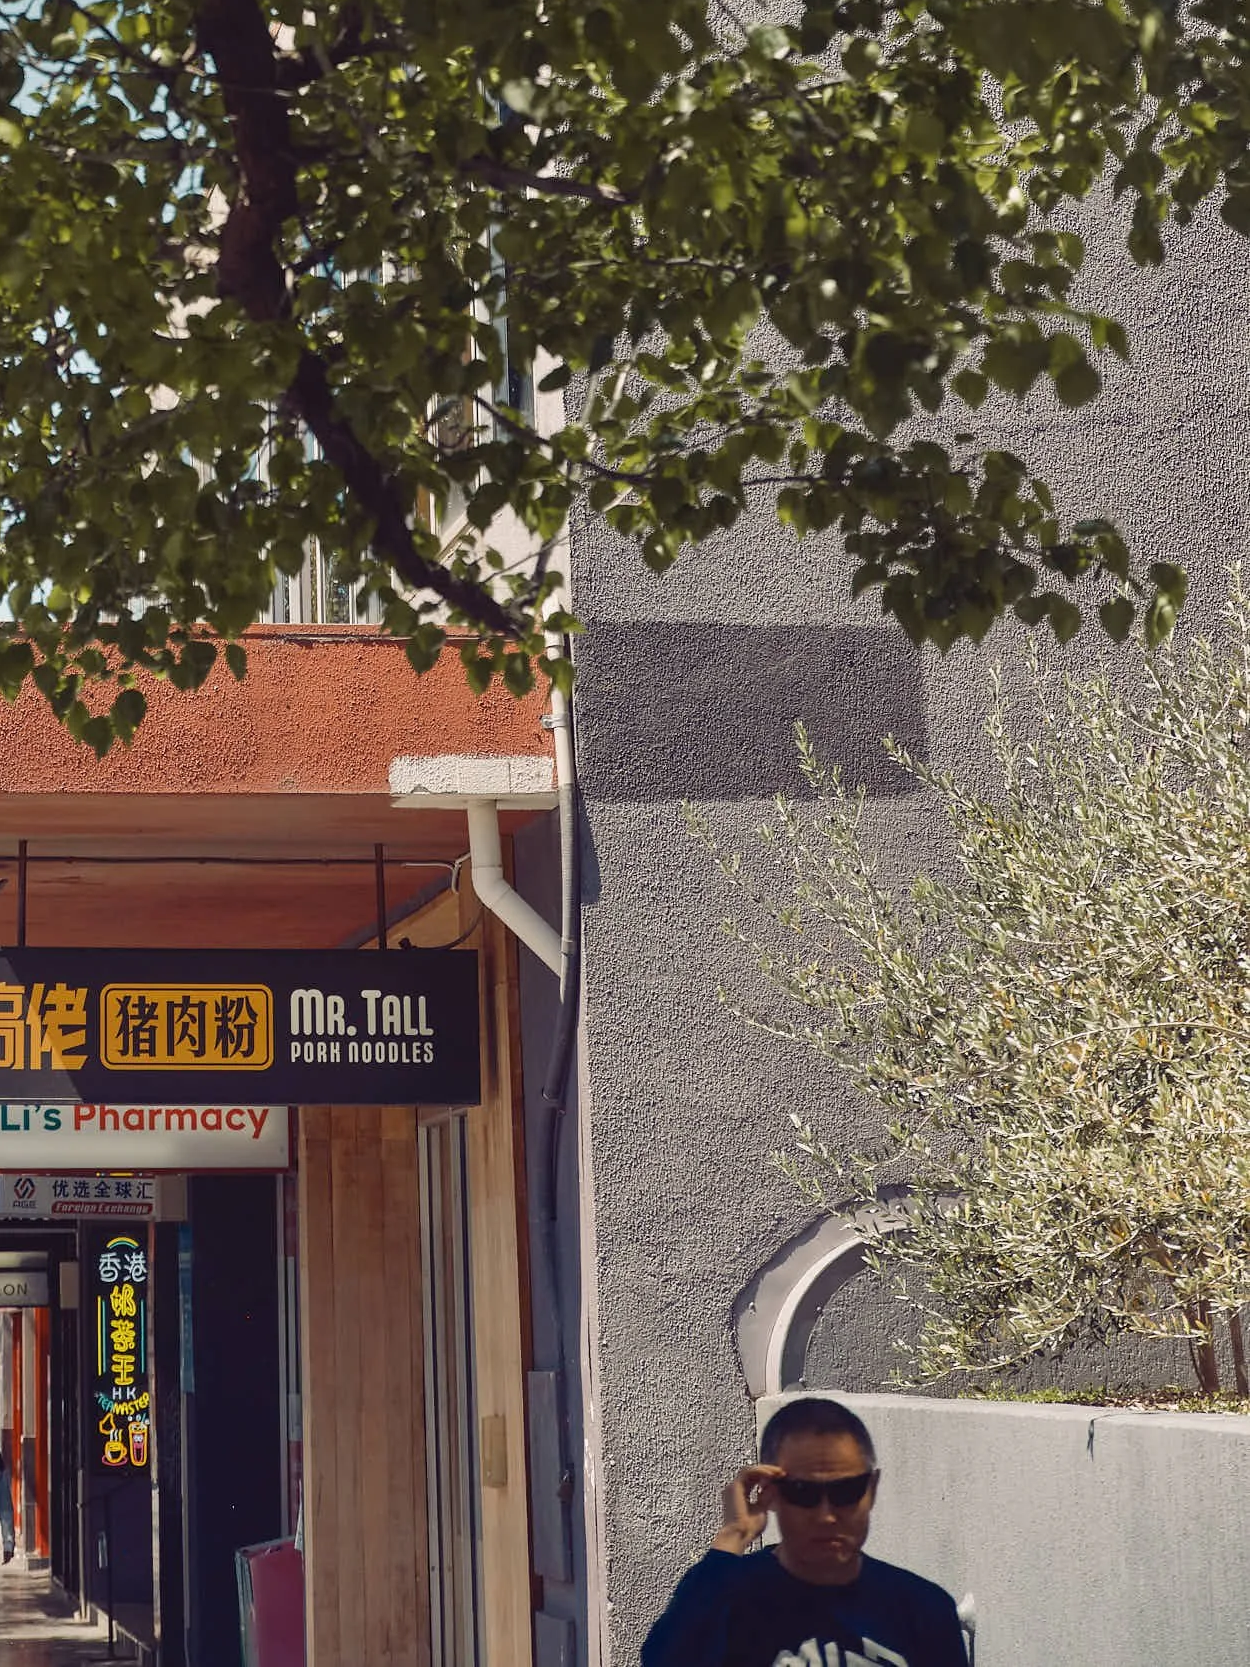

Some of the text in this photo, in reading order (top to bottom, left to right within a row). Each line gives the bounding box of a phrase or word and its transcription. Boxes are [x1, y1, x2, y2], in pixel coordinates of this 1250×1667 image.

[116, 995, 258, 1059] 猪肉粉
[291, 1042, 434, 1063] PORK NOODLES
[0, 1104, 269, 1139] Li's Pharmacy
[52, 1180, 153, 1199] 优选全球汇
[55, 1201, 149, 1214] Foreign Exchange
[99, 1251, 147, 1283] 香港
[110, 1283, 137, 1386] 奶茶王
